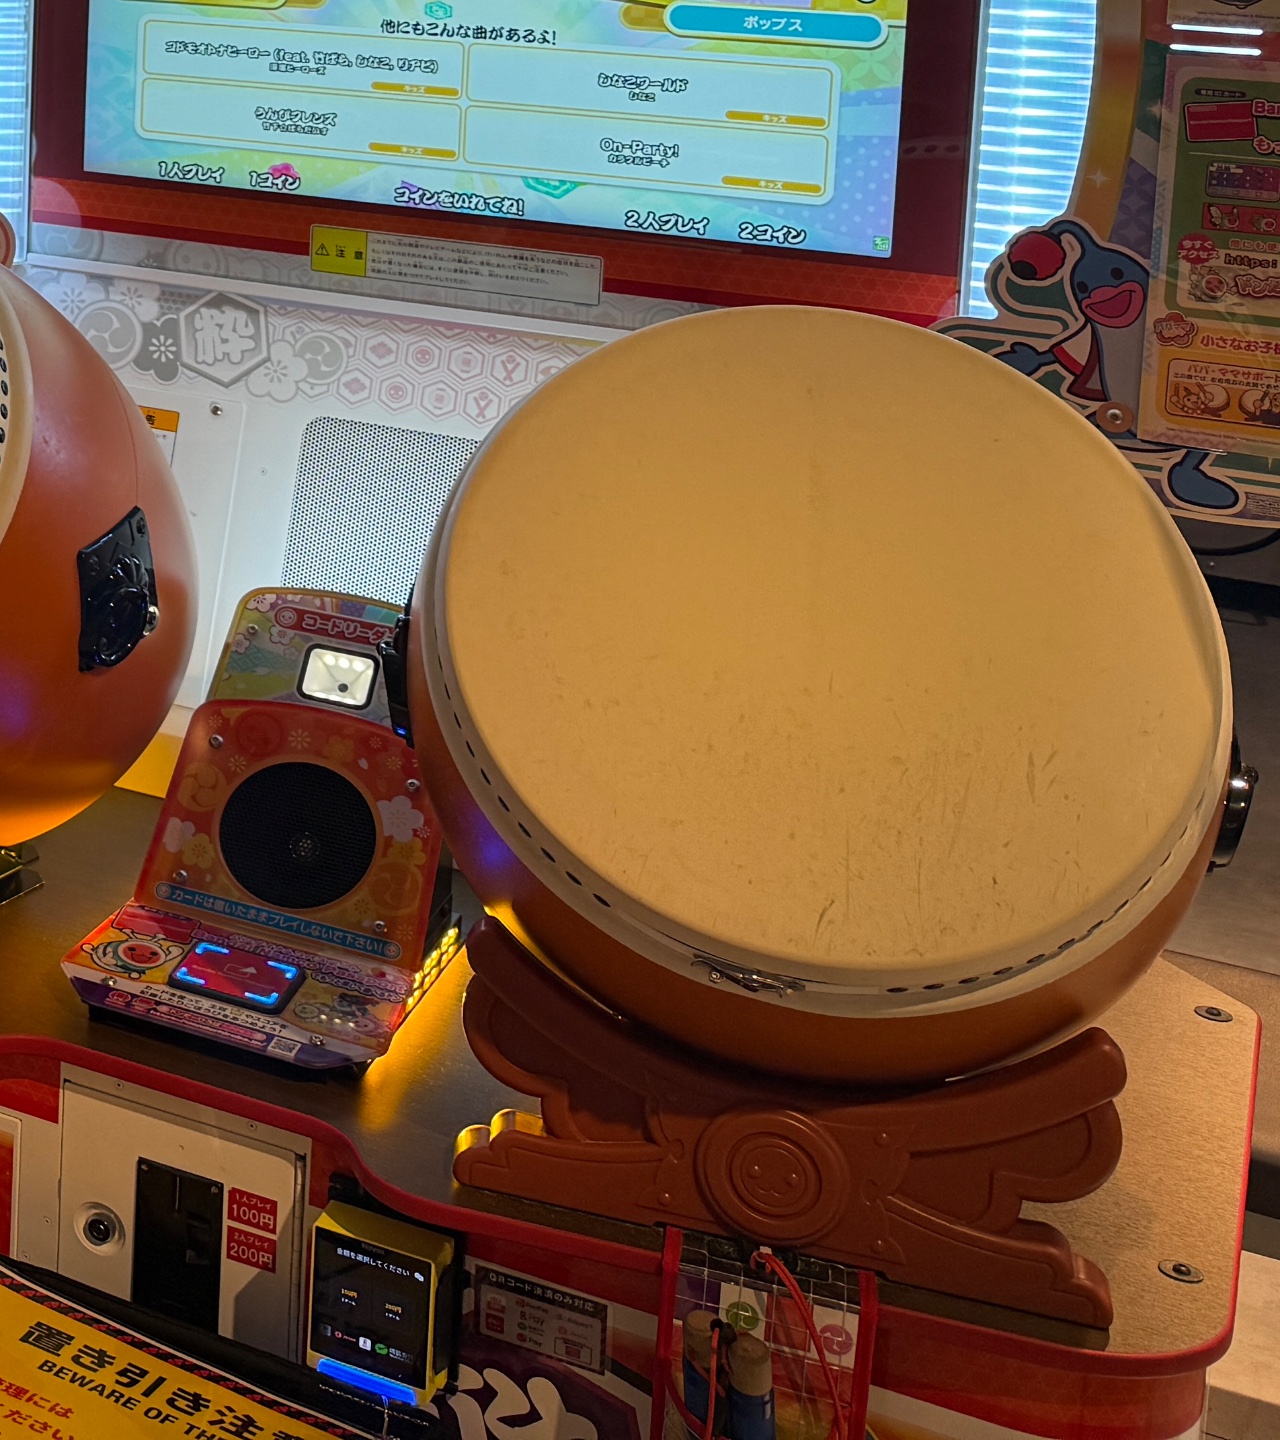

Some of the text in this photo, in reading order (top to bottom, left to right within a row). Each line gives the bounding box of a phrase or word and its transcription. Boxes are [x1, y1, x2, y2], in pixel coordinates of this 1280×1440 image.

[381, 18, 556, 45] 他にもこんな曲があるよ!
[743, 16, 802, 32] ポップス
[597, 73, 688, 94] しなこワールド
[762, 114, 787, 124] キッズ
[600, 137, 679, 158] On-Party!
[758, 180, 783, 190] キッズ
[159, 161, 807, 245] 1人プレイ 1コイン コインをいれてね! 2人プレイ 2コイン
[1178, 250, 1219, 259] アクセス
[1182, 239, 1213, 249] 今すぐ
[1224, 253, 1278, 268] https:
[173, 889, 384, 953] カードは置いたままプレイしないで下さい!
[235, 1193, 272, 1210] 1人プレイ
[232, 1203, 274, 1230] 100円
[234, 1232, 270, 1248] 2人プレイ
[230, 1242, 273, 1269] 200円
[336, 1247, 410, 1277] 金額を選択してください
[18, 1320, 305, 1440] 置き引き注
[36, 1359, 180, 1426] BEWARE OF
